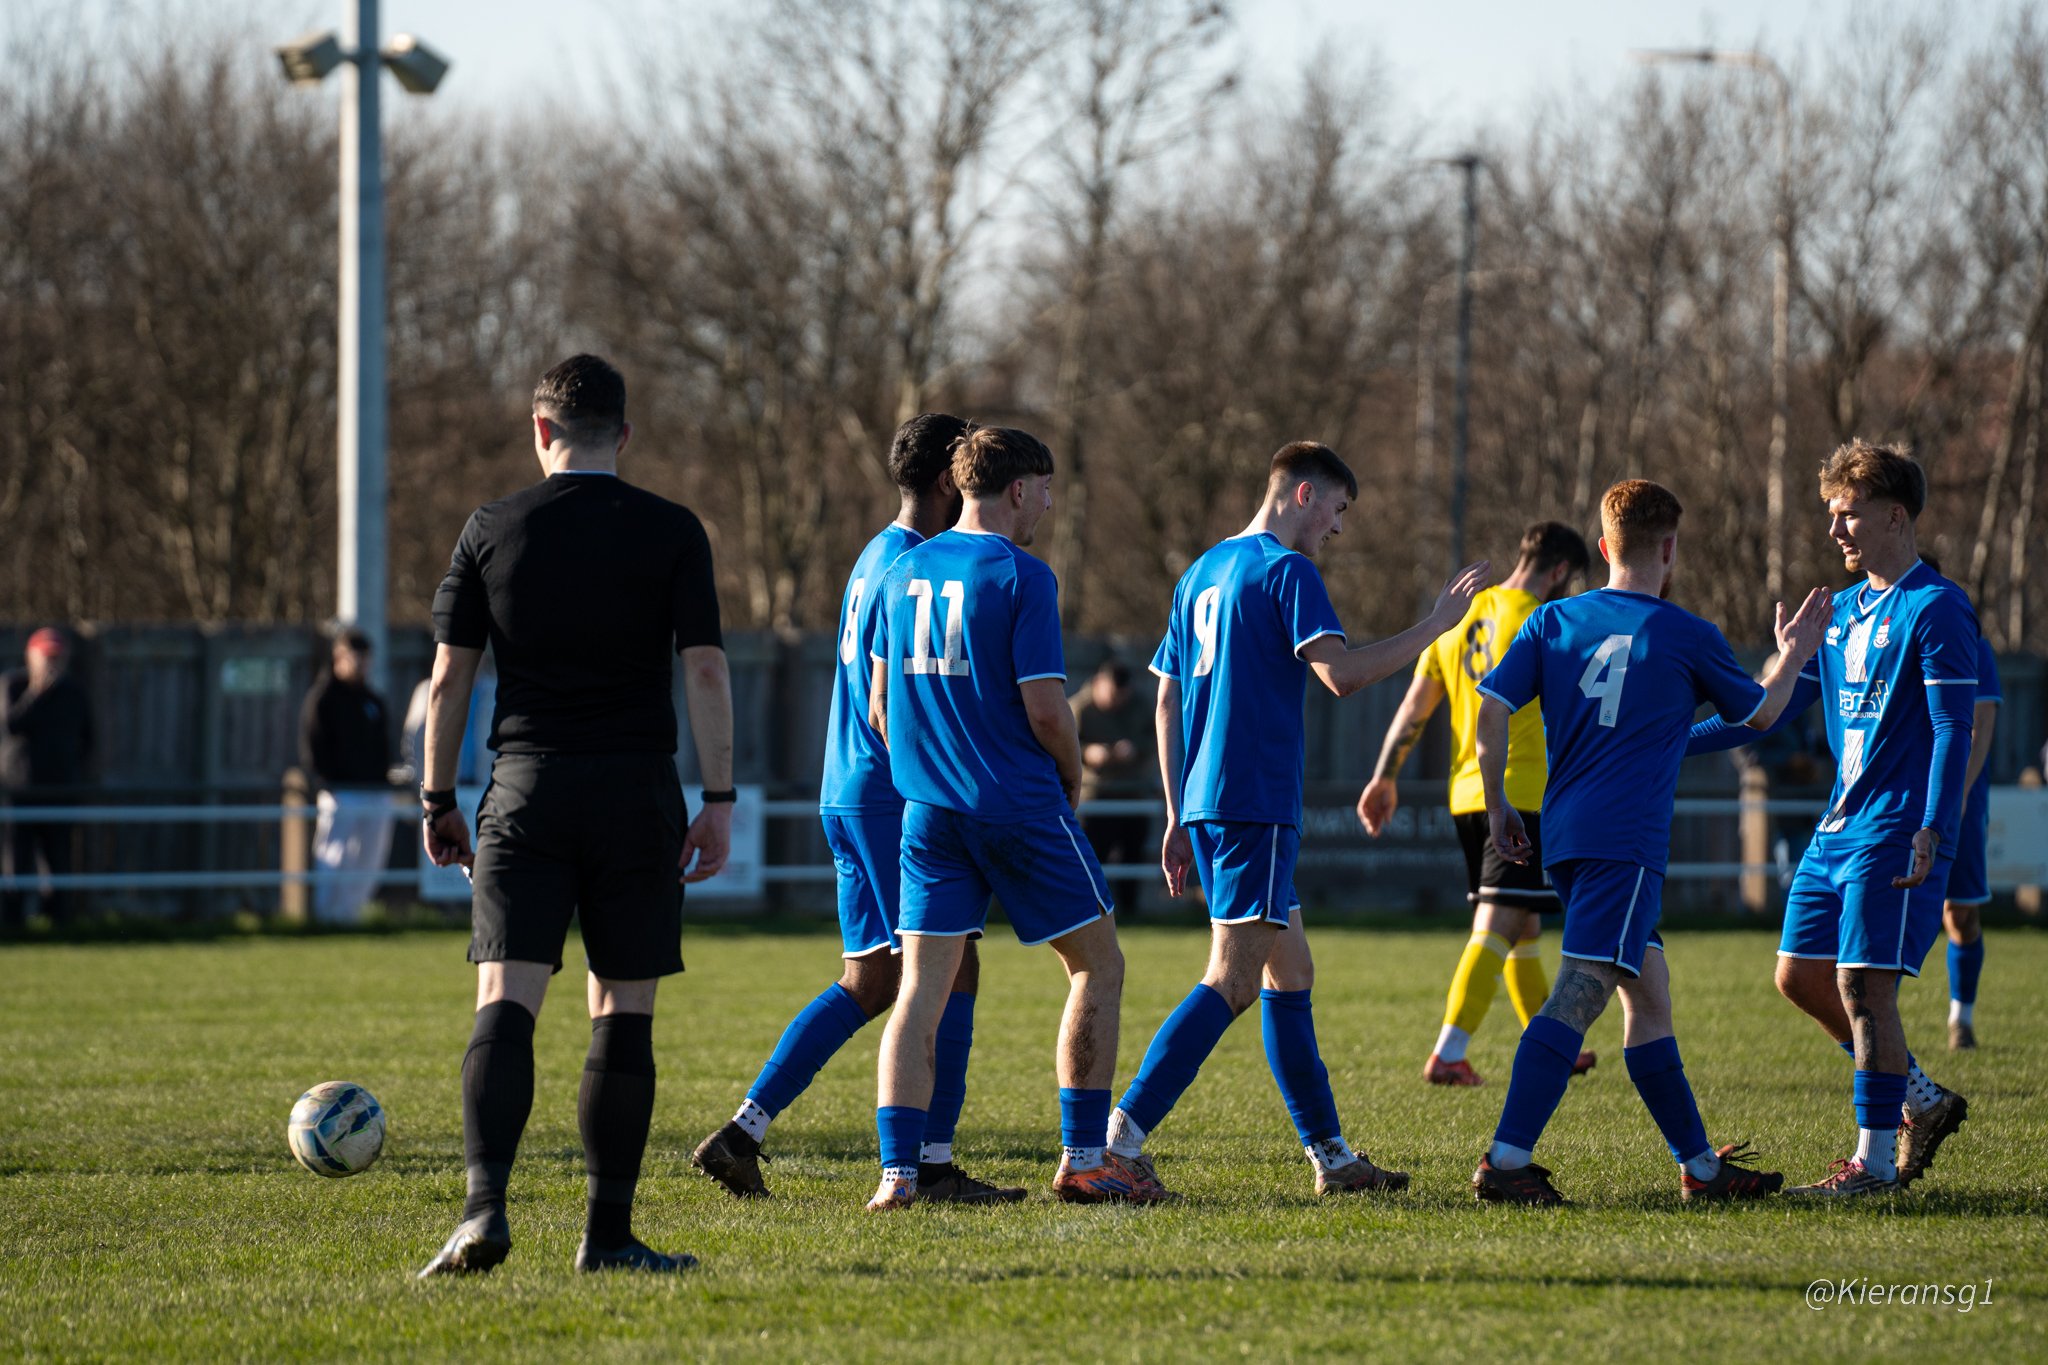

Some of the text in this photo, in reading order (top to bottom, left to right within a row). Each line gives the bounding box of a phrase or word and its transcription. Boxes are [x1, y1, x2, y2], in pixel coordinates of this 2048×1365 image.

[904, 579, 969, 676] 11
[1193, 585, 1220, 677] 9
[1463, 619, 1495, 681] 8
[1578, 634, 1633, 729] 4
